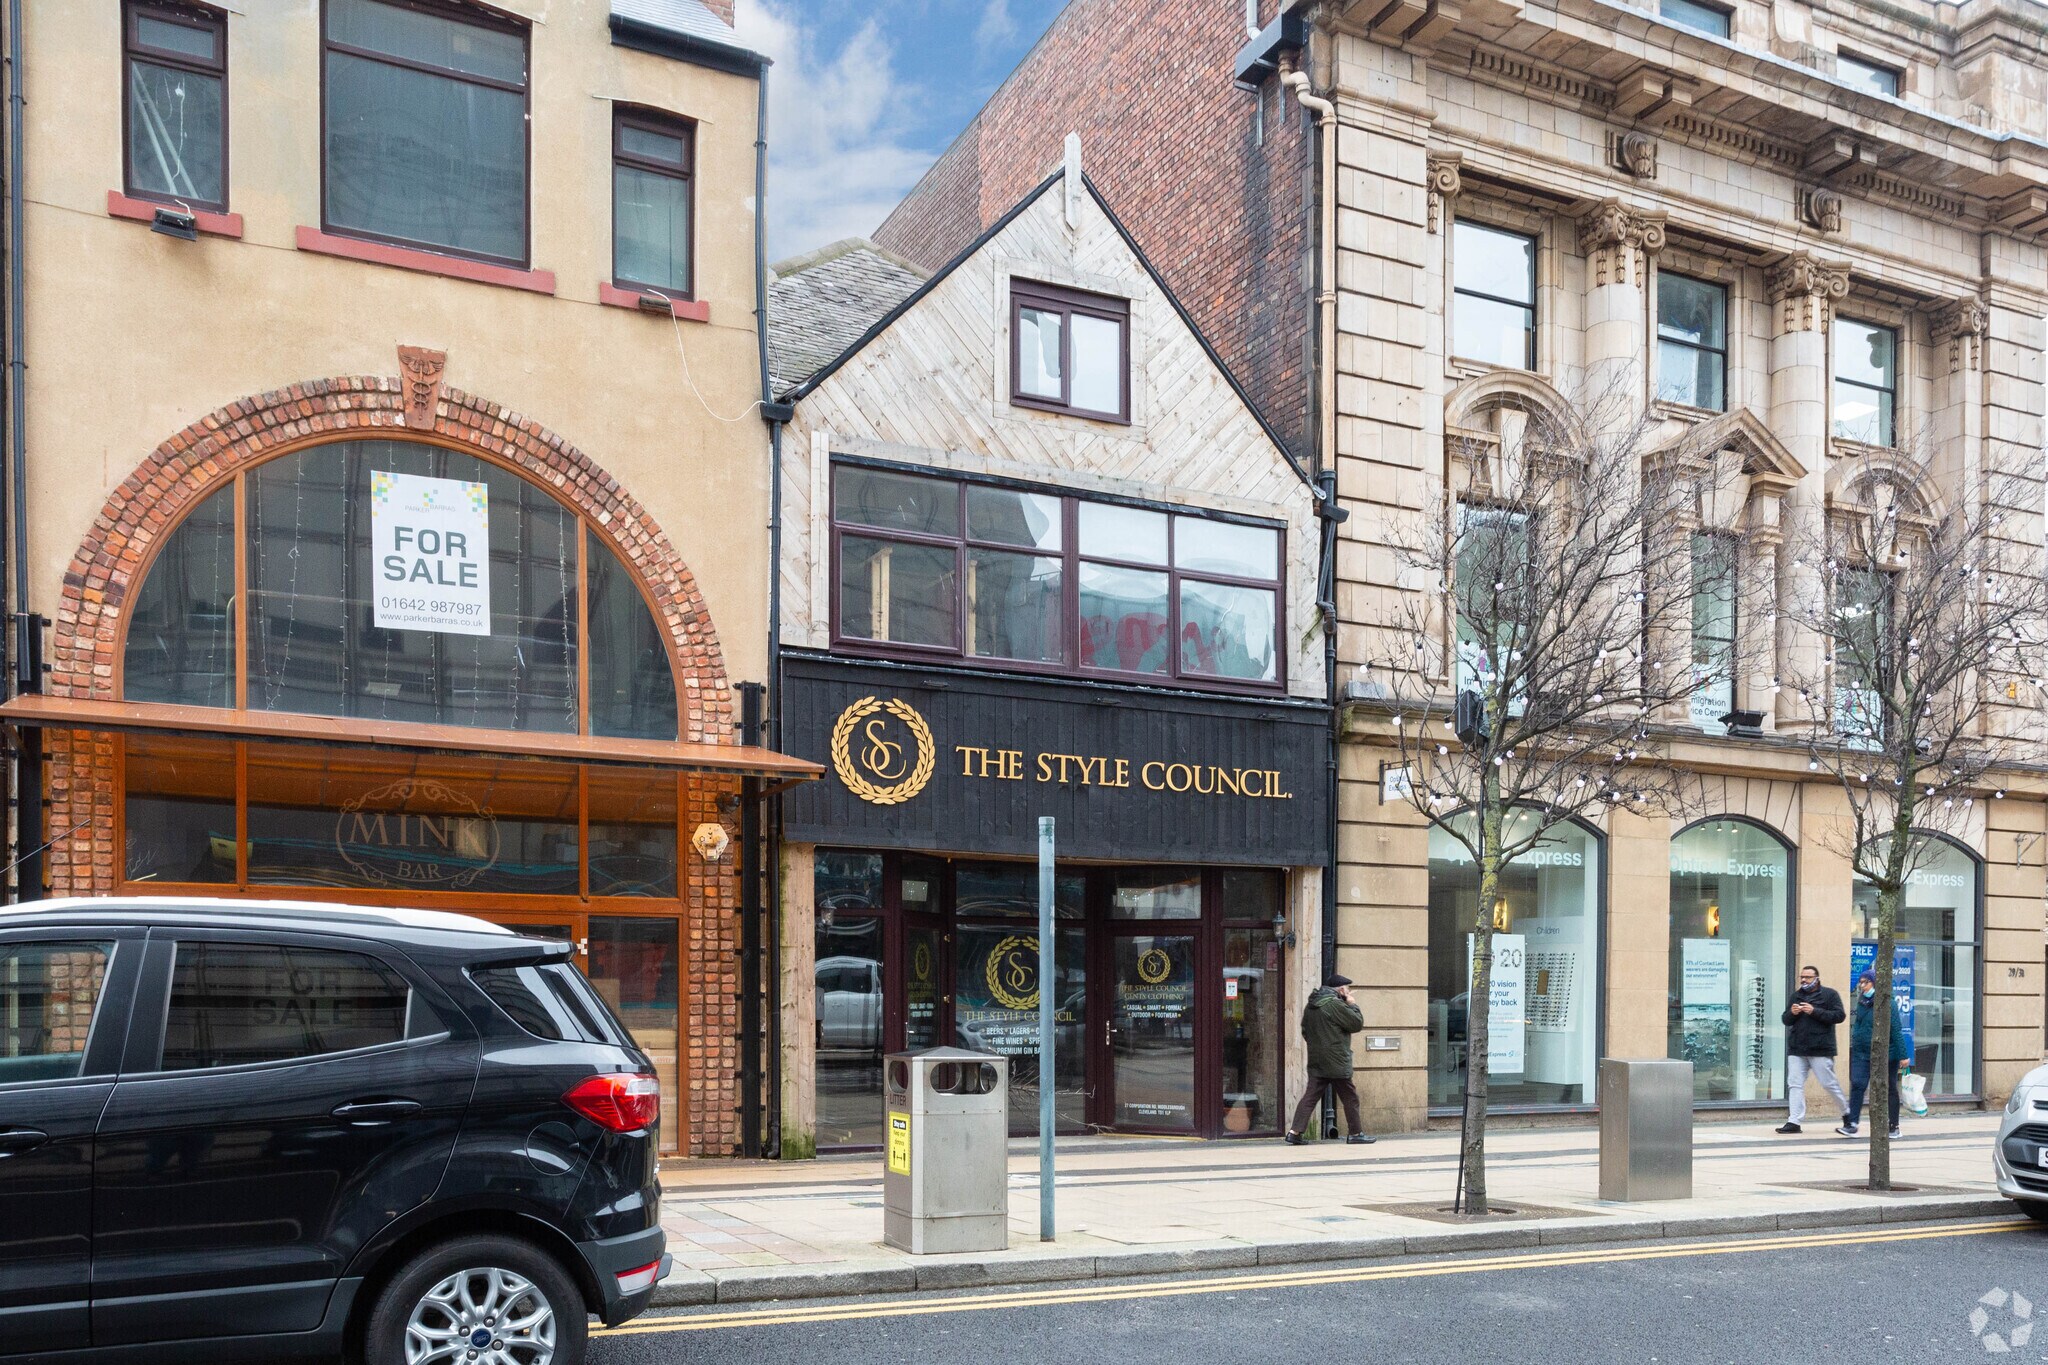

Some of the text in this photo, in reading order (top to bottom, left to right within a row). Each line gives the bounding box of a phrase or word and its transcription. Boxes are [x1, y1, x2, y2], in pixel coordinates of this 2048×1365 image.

[394, 525, 467, 558] FOR
[383, 555, 478, 589] SALE
[381, 596, 482, 616] 01642 987987
[380, 612, 483, 627] www.parkerbarras.co.uk
[1691, 697, 1726, 707] migration
[956, 745, 1024, 780] THE
[1036, 752, 1130, 788] STYLE
[347, 811, 489, 858] MINK
[398, 861, 441, 879] BAR
[1727, 858, 1785, 879] Express
[1914, 869, 1964, 888] Express
[1500, 948, 1522, 968] 20
[1851, 946, 1873, 956] FREE
[1497, 979, 1517, 988] vision
[1494, 991, 1510, 999] your
[1501, 998, 1517, 1006] back
[252, 1000, 352, 1026] SALE
[964, 1011, 985, 1021] THE
[989, 1011, 1020, 1021] STYLE
[1009, 1027, 1031, 1035] LAGERS
[992, 1037, 1004, 1045] FINE
[1005, 1037, 1023, 1045] WINES
[996, 1046, 1023, 1055] PREMIUM
[1023, 1047, 1033, 1055] GIN
[889, 1093, 907, 1106] LITTER
